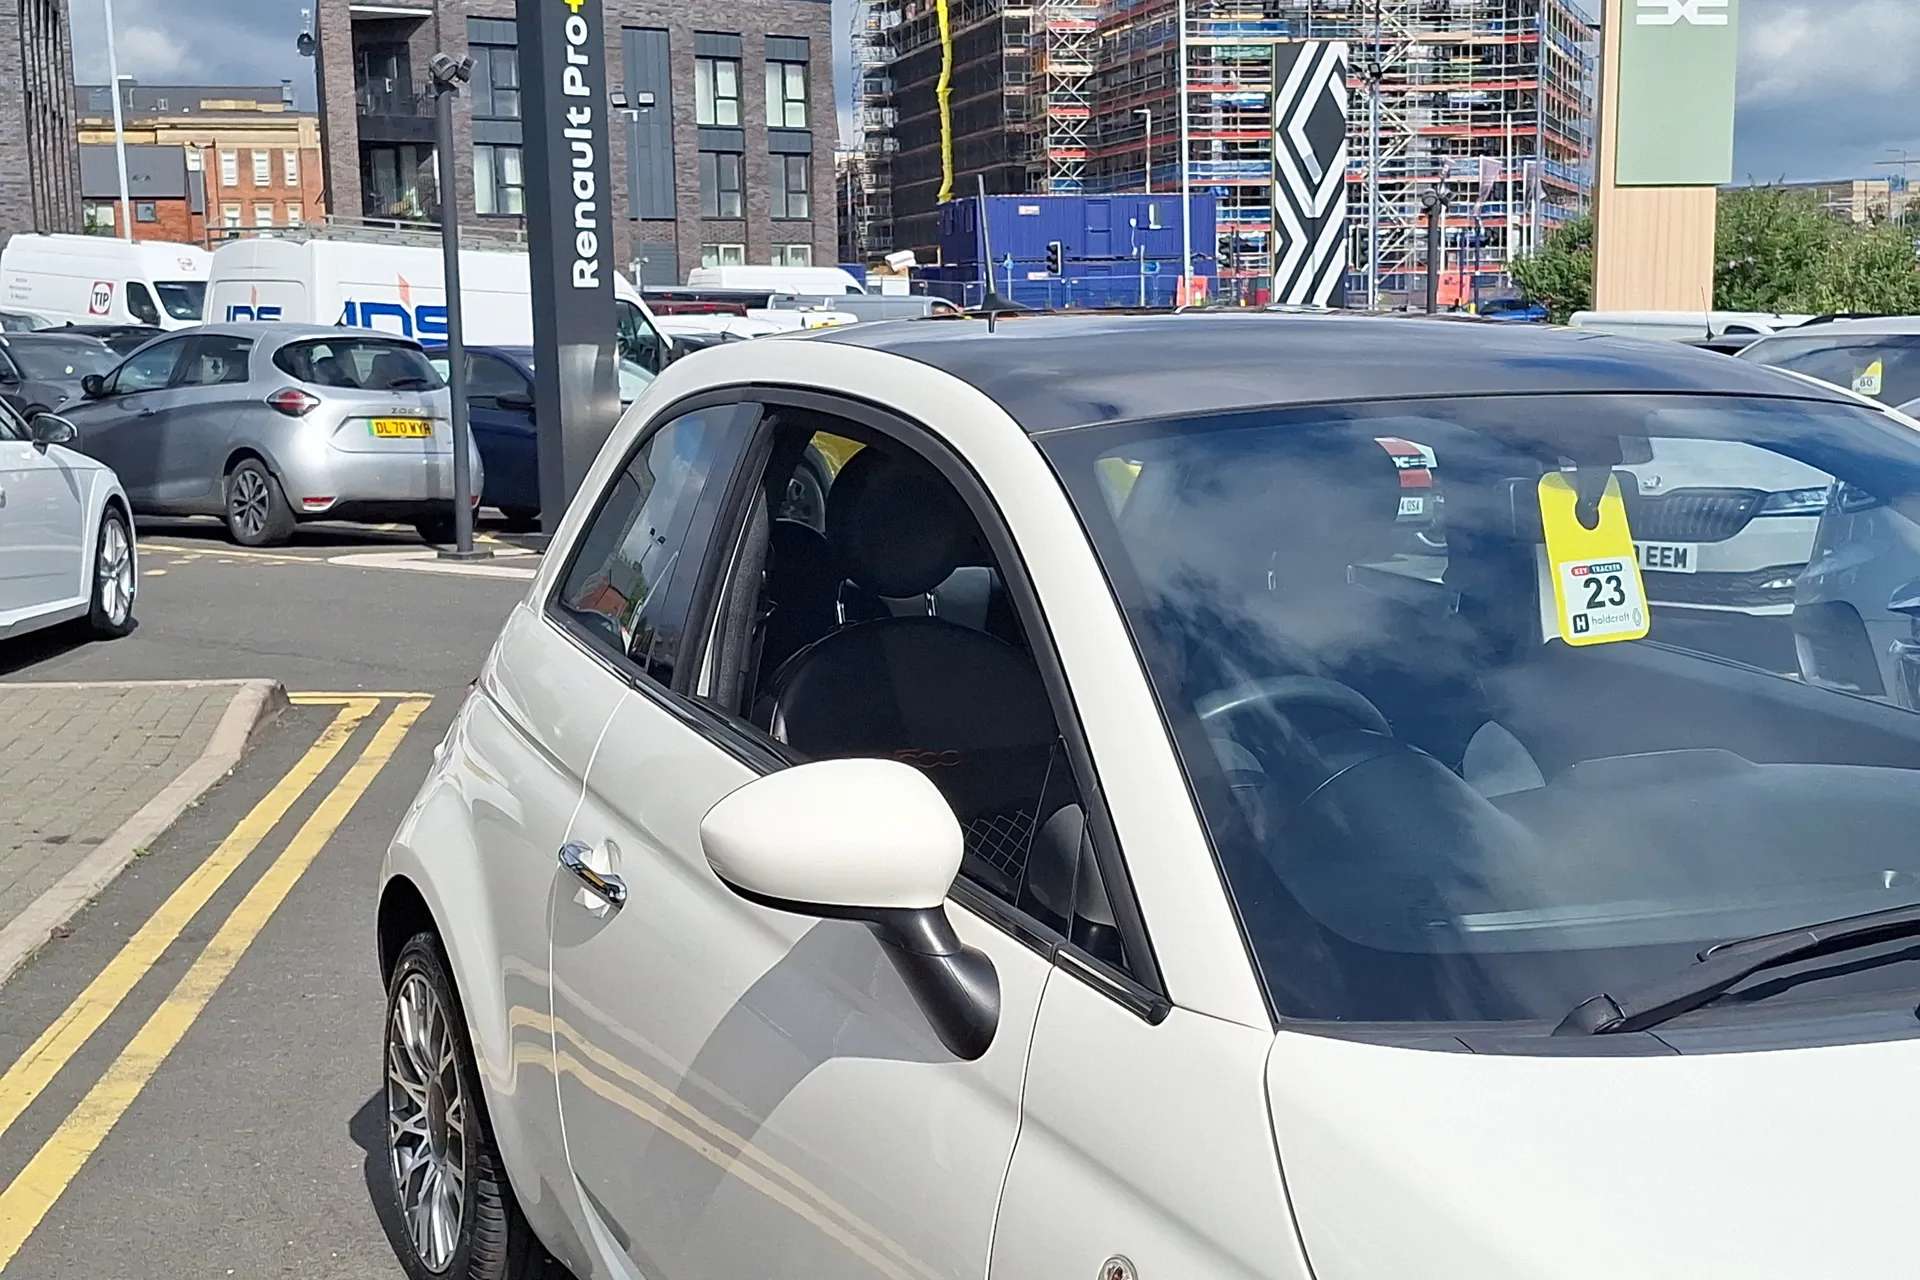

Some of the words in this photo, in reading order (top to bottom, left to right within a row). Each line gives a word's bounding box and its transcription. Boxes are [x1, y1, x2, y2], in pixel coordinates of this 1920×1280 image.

[564, 106, 600, 289] Renault
[94, 292, 109, 307] TIP
[1573, 566, 1589, 576] KEY
[1583, 575, 1626, 609] 23
